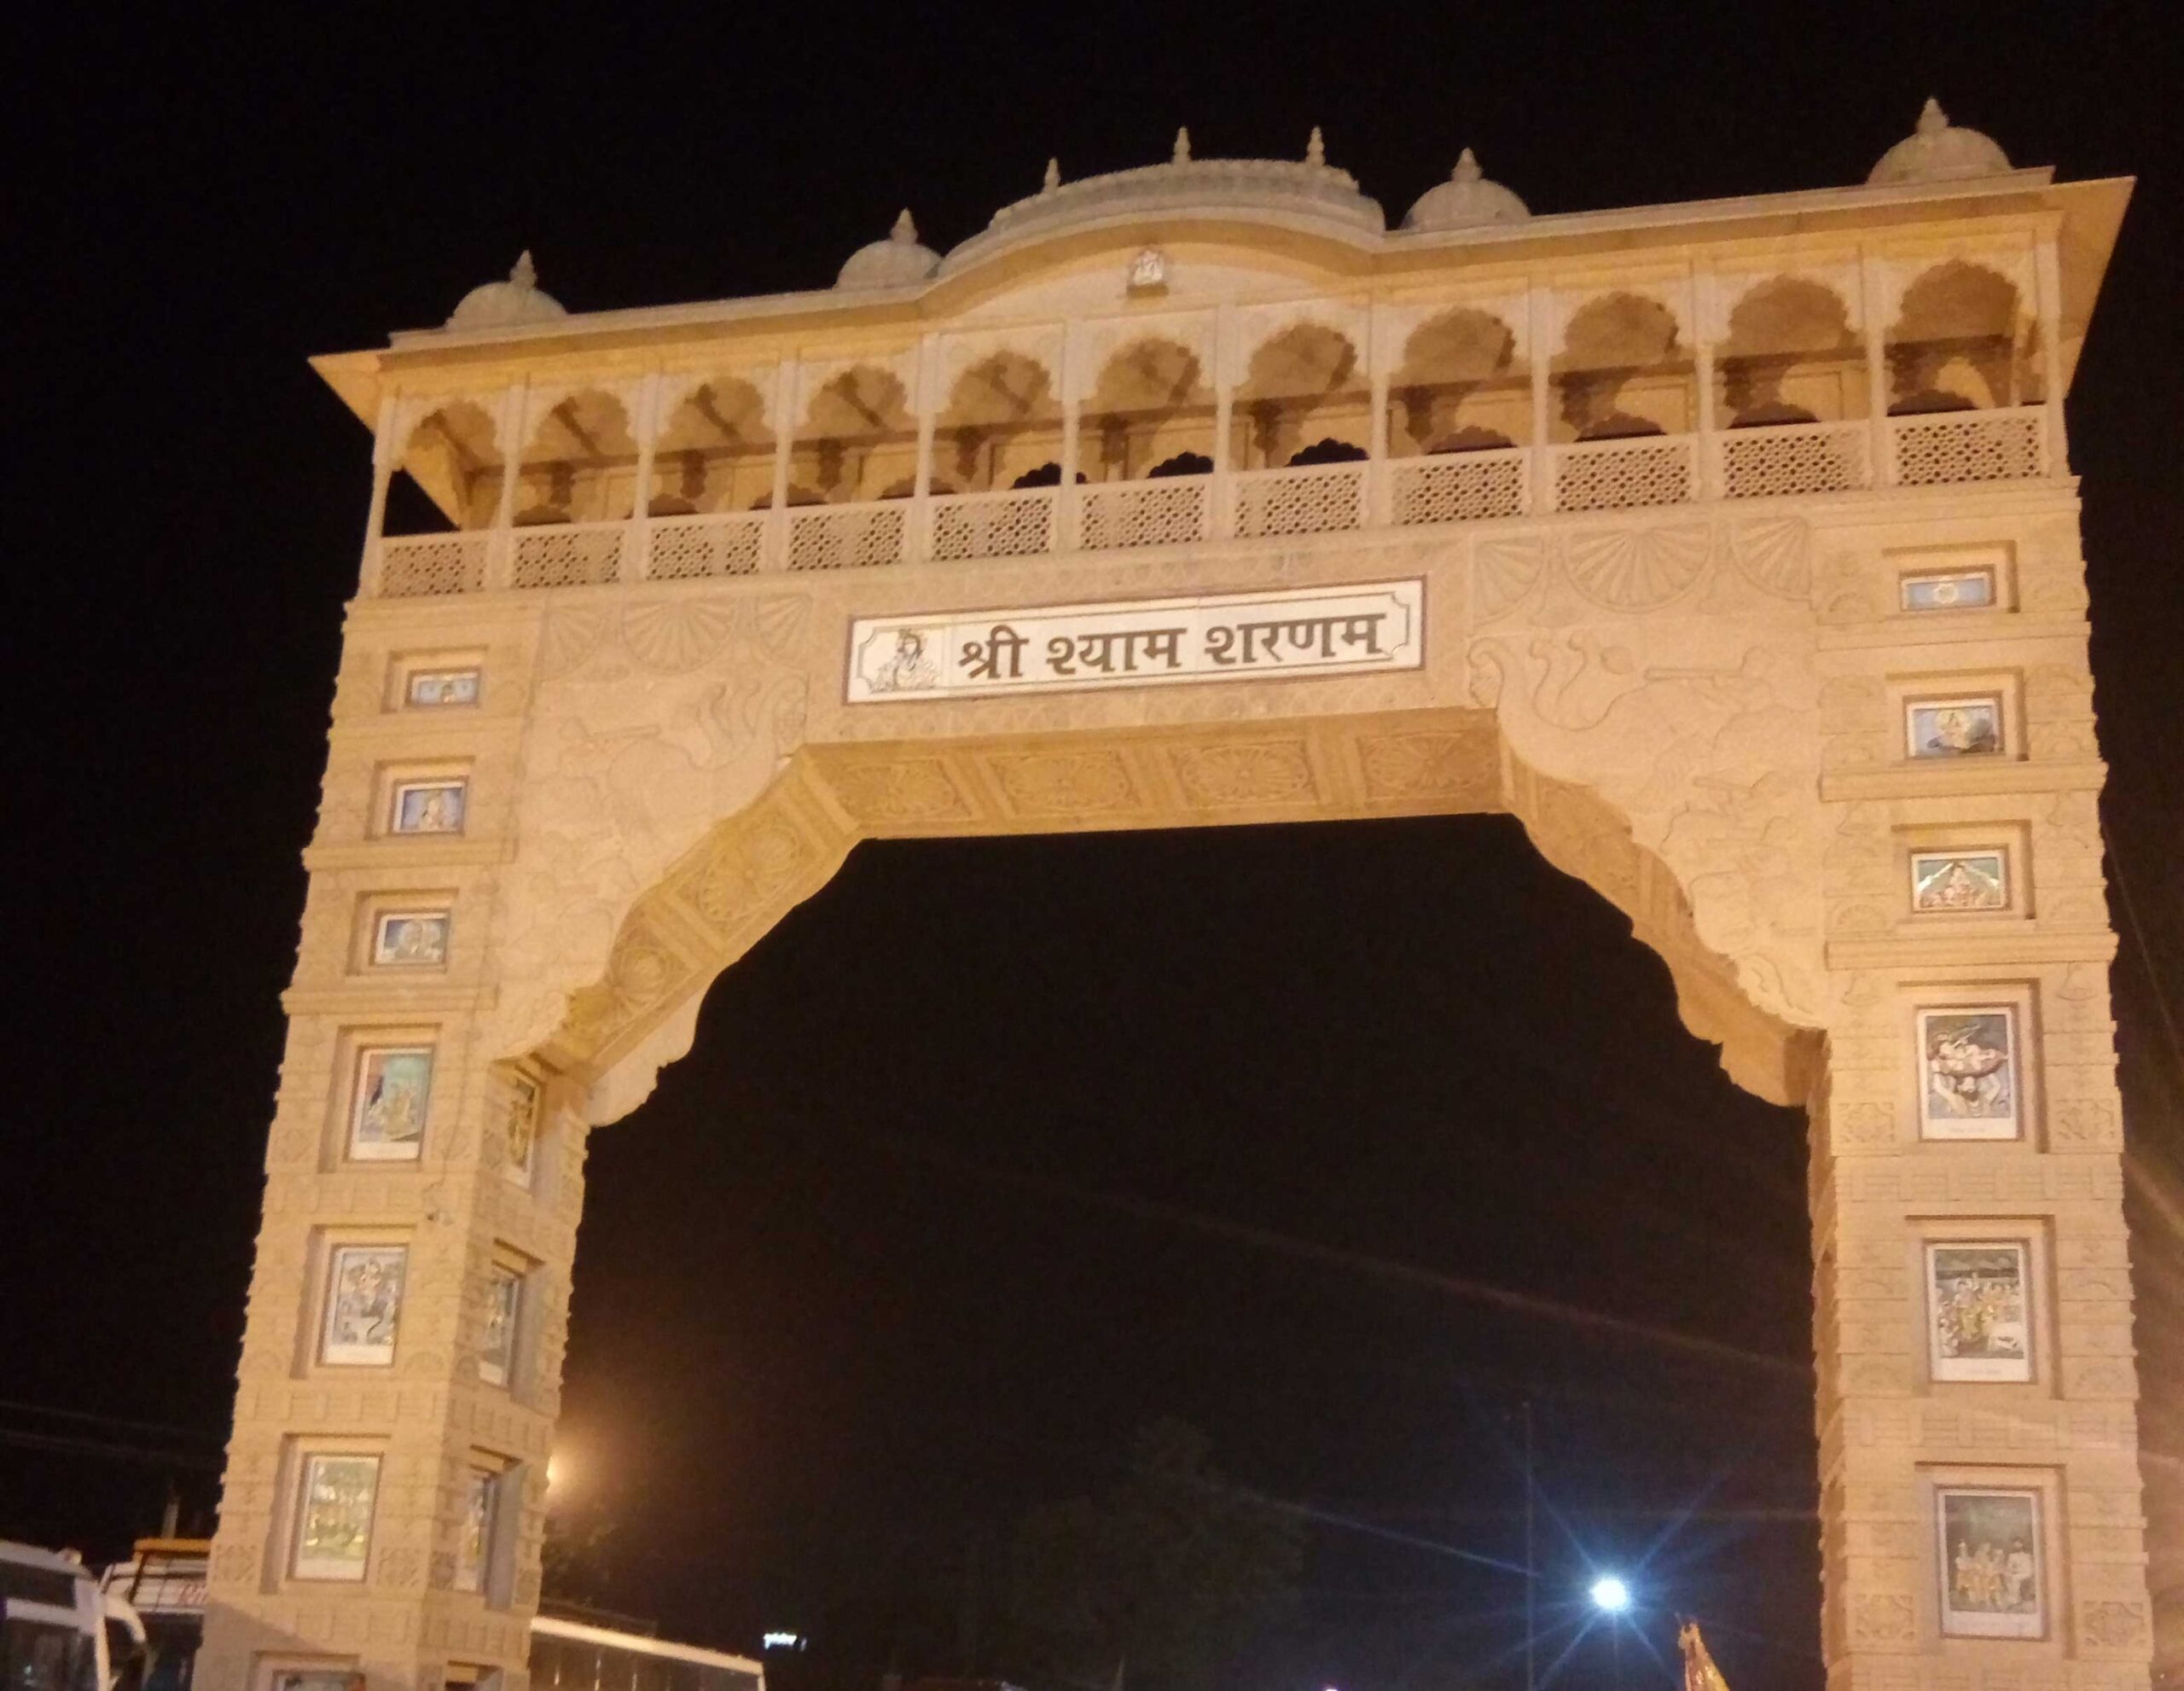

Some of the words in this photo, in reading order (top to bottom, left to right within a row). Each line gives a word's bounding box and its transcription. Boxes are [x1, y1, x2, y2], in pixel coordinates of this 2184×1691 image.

[958, 625, 1029, 679] श्री
[1046, 628, 1187, 676] श्याम
[1205, 613, 1386, 665] शरणम
